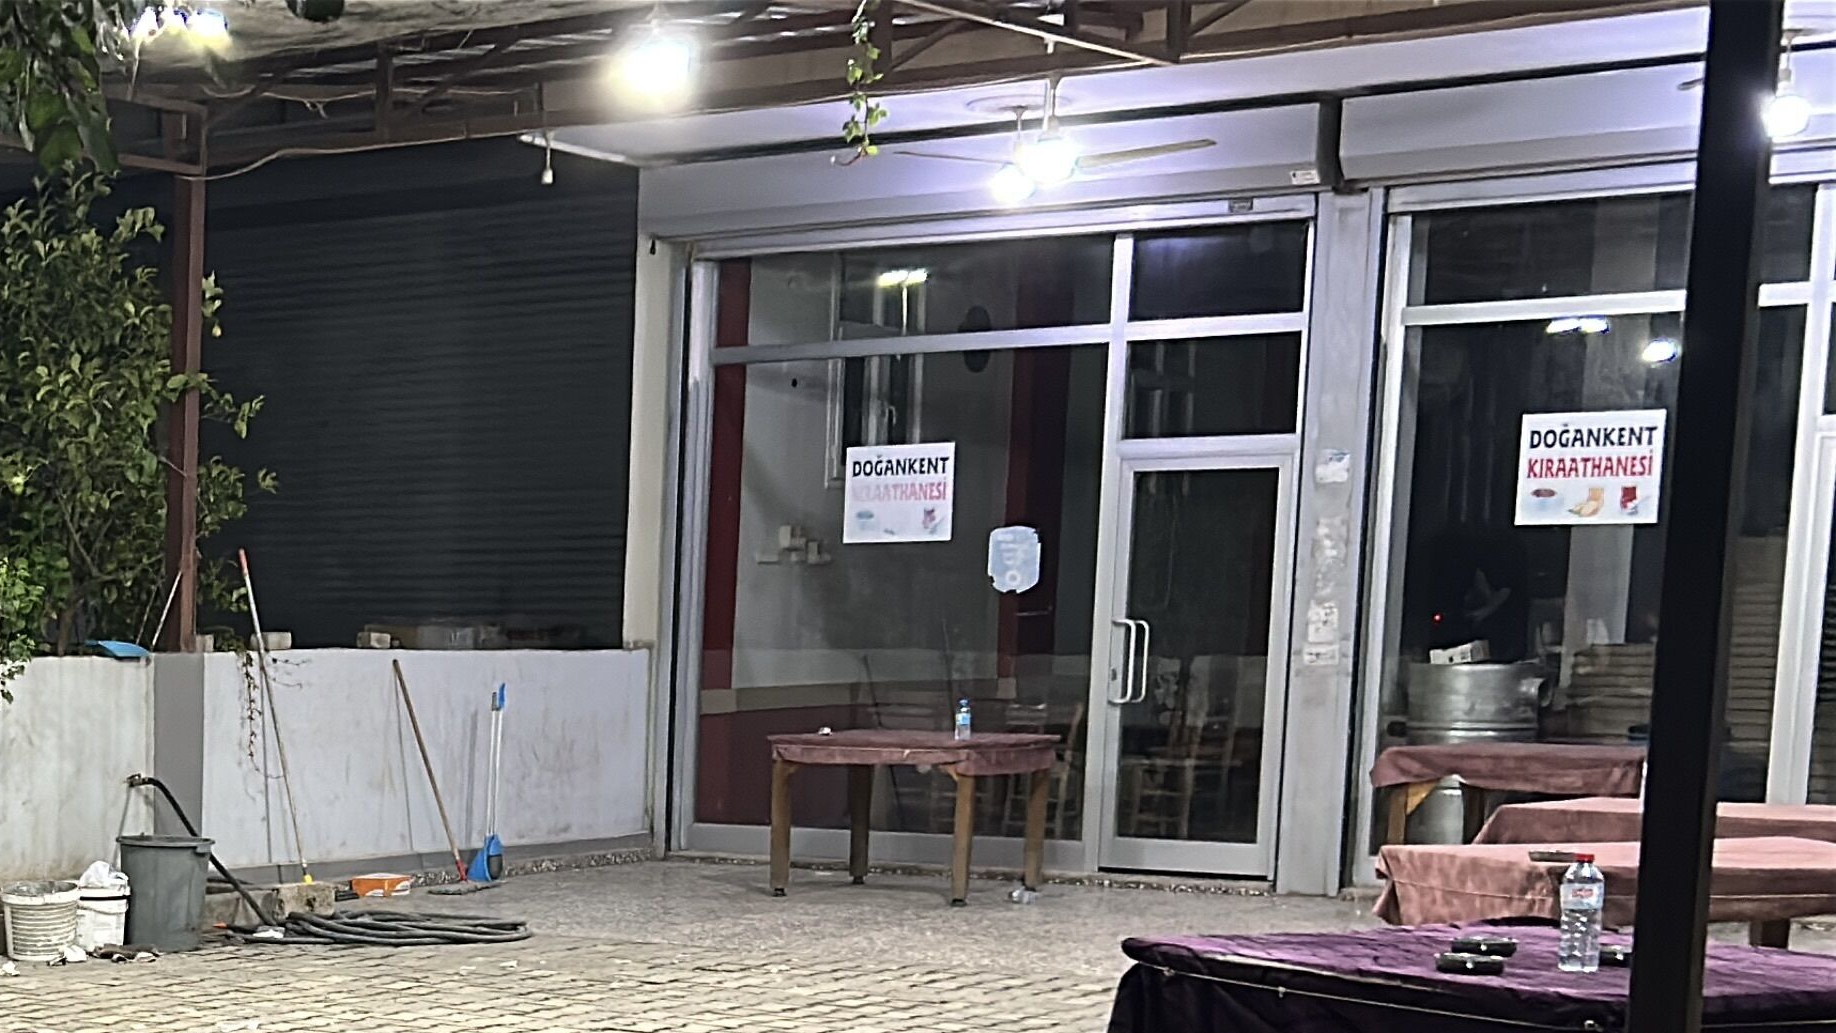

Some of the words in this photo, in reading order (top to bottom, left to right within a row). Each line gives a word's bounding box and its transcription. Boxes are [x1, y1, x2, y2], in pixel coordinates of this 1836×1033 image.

[1530, 423, 1658, 448] DOĞANKENT
[852, 454, 950, 477] DOĞANKENT
[1527, 450, 1653, 478] KIRAATHANESİ
[852, 477, 947, 502] AATHANESİ
